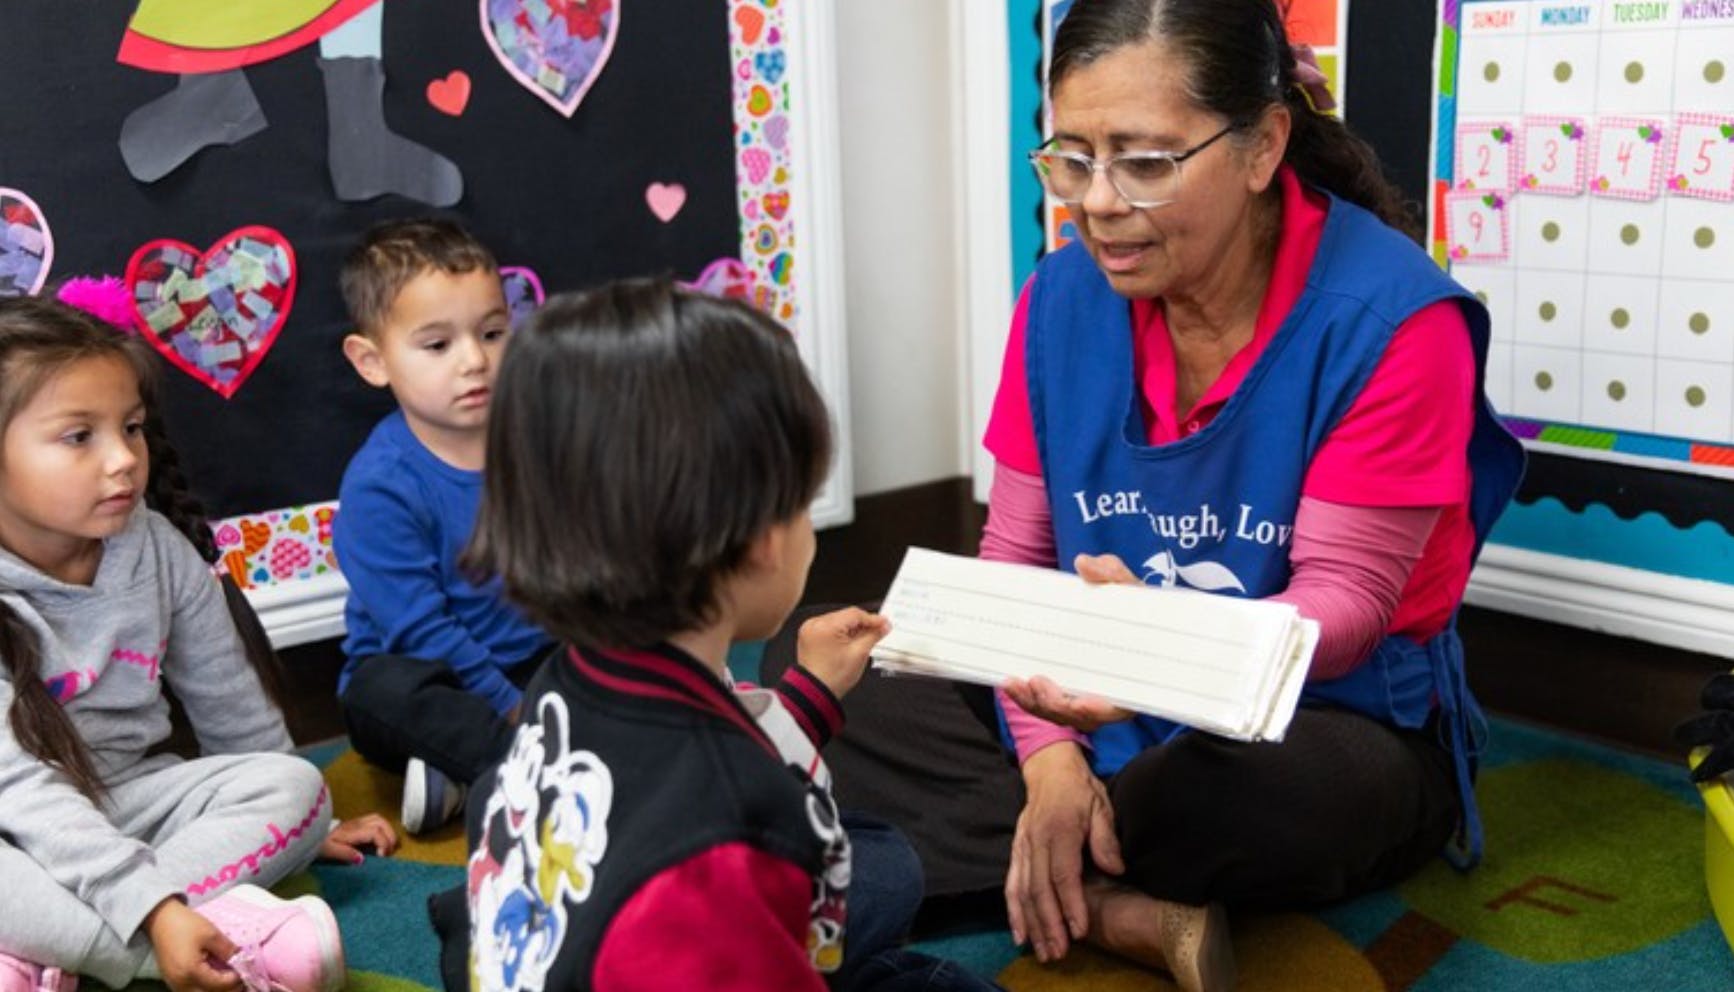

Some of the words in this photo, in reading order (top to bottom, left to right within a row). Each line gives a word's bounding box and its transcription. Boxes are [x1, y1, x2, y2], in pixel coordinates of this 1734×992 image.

[1472, 9, 1515, 28] SUNDAY
[1541, 6, 1590, 25] MONDAY
[1614, 2, 1669, 22] TUESDAY
[1681, 0, 1734, 18] WEDNES
[1478, 144, 1491, 178] 2
[1542, 139, 1559, 172] 3
[1617, 141, 1634, 176] 4
[1693, 139, 1717, 175] 5
[1469, 211, 1483, 243] 9
[1073, 490, 1147, 523] Lear
[1148, 504, 1227, 549] ugh,
[1236, 504, 1294, 547] Lov
[1484, 876, 1619, 917] F
